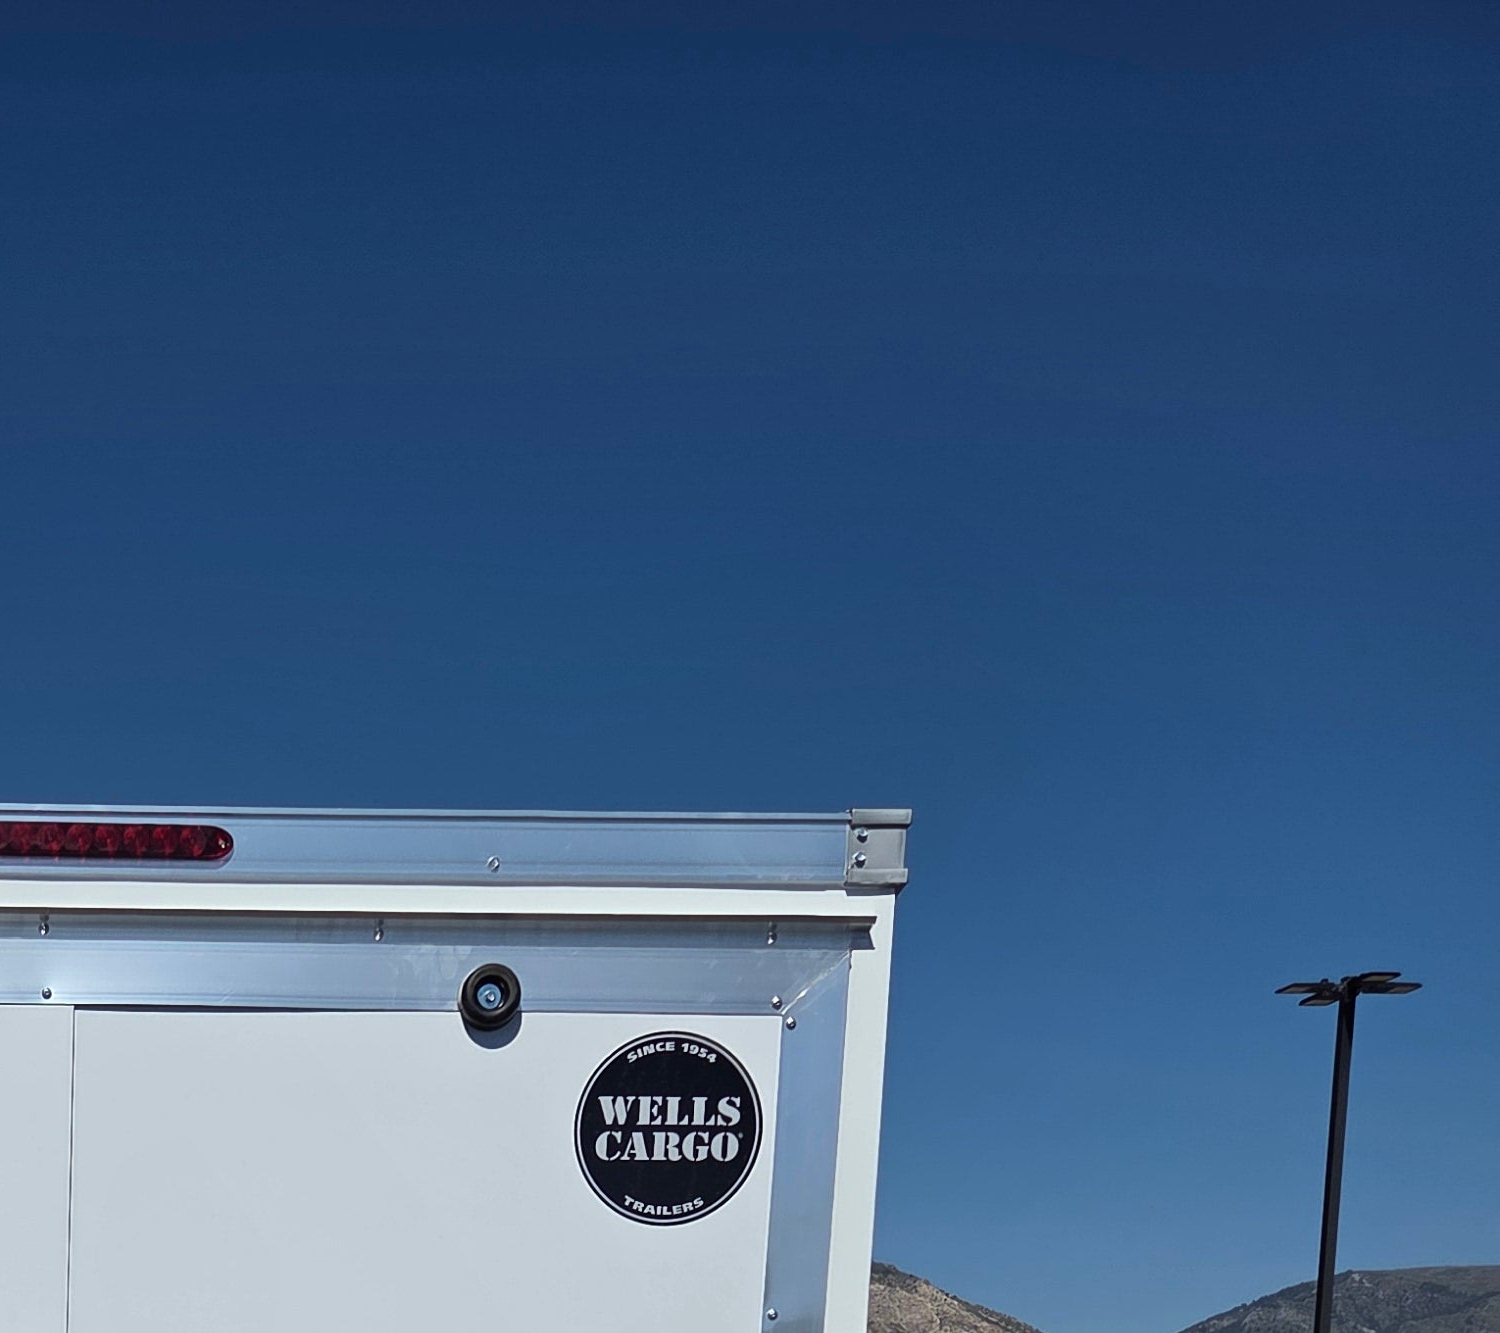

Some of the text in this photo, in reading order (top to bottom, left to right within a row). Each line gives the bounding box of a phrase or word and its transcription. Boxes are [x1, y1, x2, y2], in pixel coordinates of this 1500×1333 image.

[626, 1041, 718, 1064] SINCE 1954
[597, 1095, 742, 1127] WELLS
[595, 1130, 740, 1162] CARGO
[623, 1195, 705, 1216] TRAILERS
